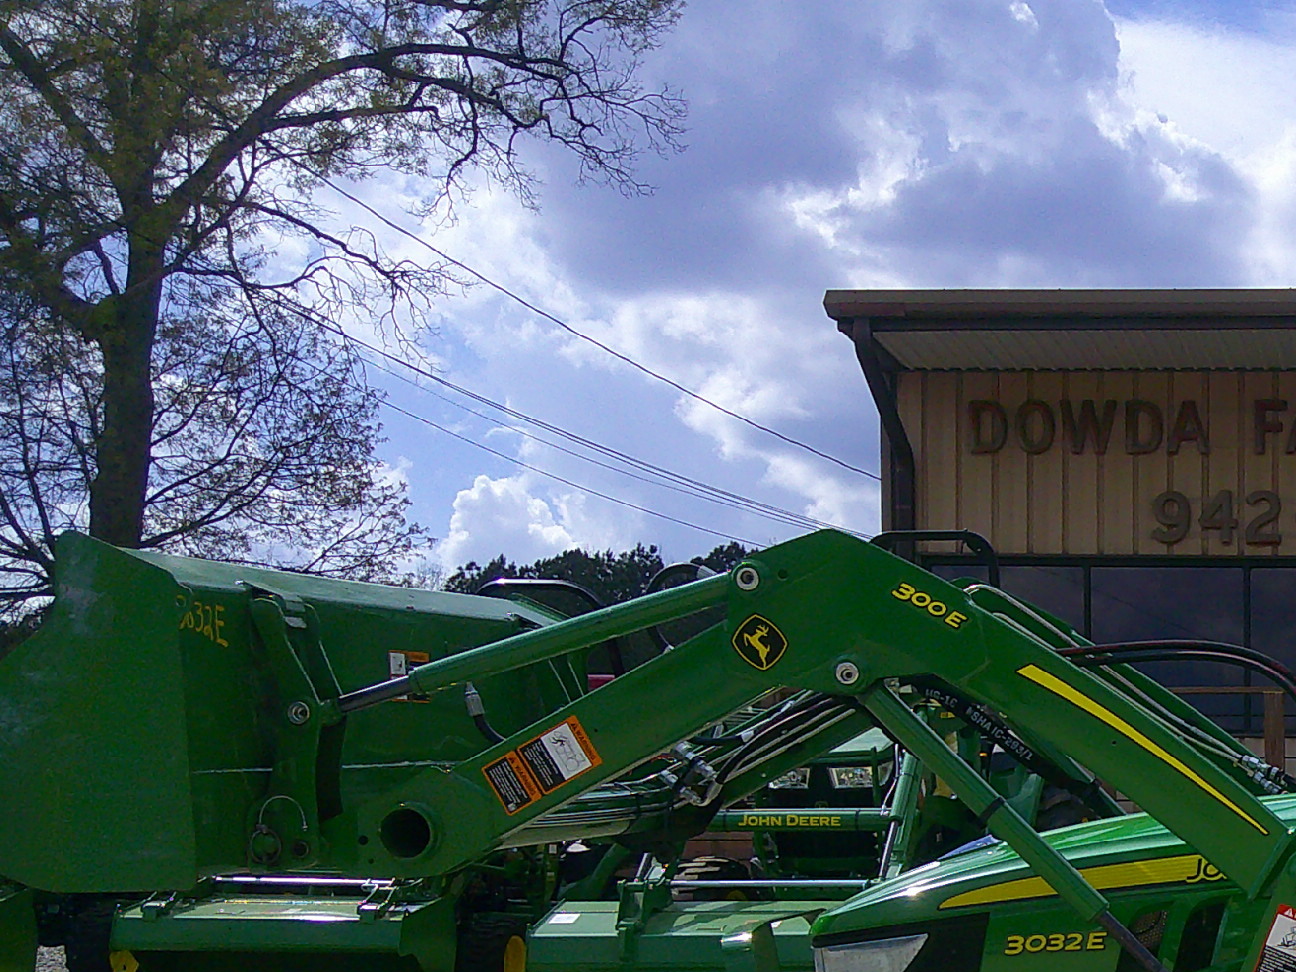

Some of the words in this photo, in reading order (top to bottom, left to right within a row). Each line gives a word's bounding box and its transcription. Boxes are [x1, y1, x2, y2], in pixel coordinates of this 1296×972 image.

[967, 398, 1211, 456] DOWDA
[738, 815, 782, 826] JOHN
[786, 815, 841, 826] DEERE
[1003, 931, 1107, 956] 3032E
